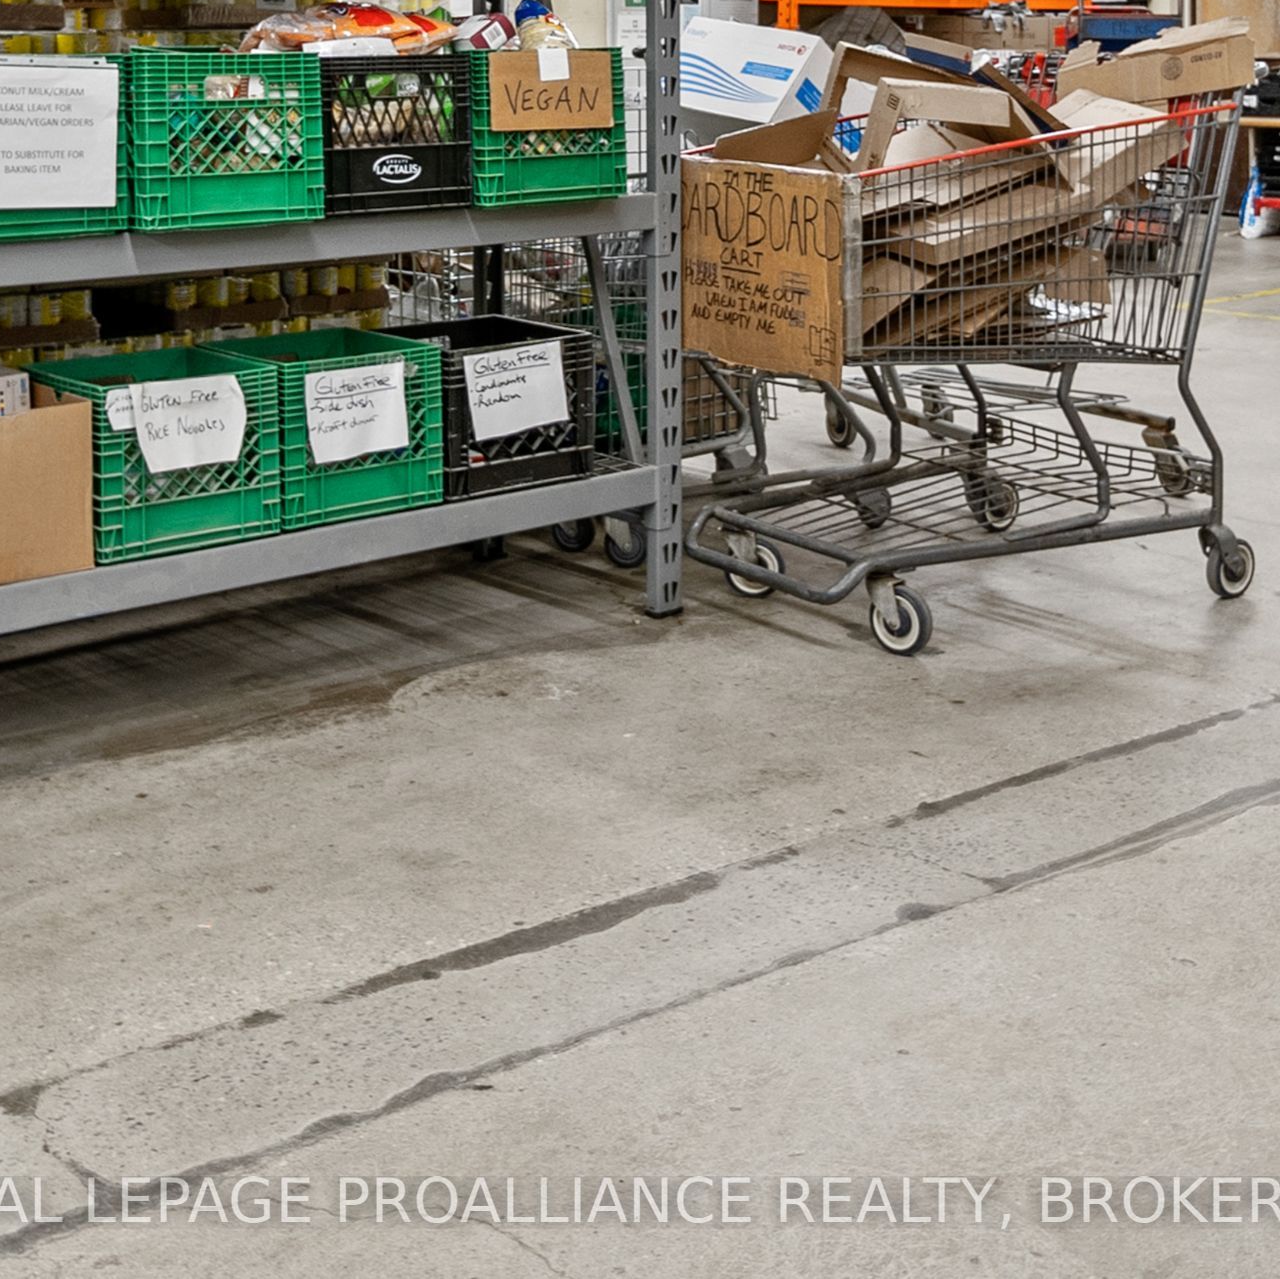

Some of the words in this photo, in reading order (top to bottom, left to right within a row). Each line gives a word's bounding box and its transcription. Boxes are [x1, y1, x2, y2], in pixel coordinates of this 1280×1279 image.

[28, 87, 85, 97] MILK/CREAM
[504, 80, 600, 115] VEGAN
[27, 103, 52, 112] LEAVE
[55, 103, 72, 112] FOR
[60, 118, 94, 127] ORDERS
[1, 150, 12, 159] TO
[14, 150, 65, 159] SUBSTITUTE
[67, 150, 85, 159] FOR
[4, 165, 37, 174] BAKING
[39, 165, 61, 174] ITEM
[376, 164, 418, 175] LACTALIS
[745, 172, 773, 192] THE
[681, 181, 842, 261] ARDBOARD
[721, 247, 763, 268] CART
[724, 276, 751, 297] TAKE
[754, 284, 771, 300] ME
[773, 288, 806, 305] OUT
[705, 291, 736, 308] WHEN
[738, 297, 748, 311] I
[749, 300, 768, 314] AM
[692, 304, 710, 320] AND
[715, 310, 751, 330] EMPTY
[756, 320, 776, 335] ME
[473, 356, 516, 375] Gluten
[517, 349, 549, 364] Free
[314, 375, 359, 395] Gluten
[189, 390, 219, 403] Free
[145, 422, 170, 442] RICE
